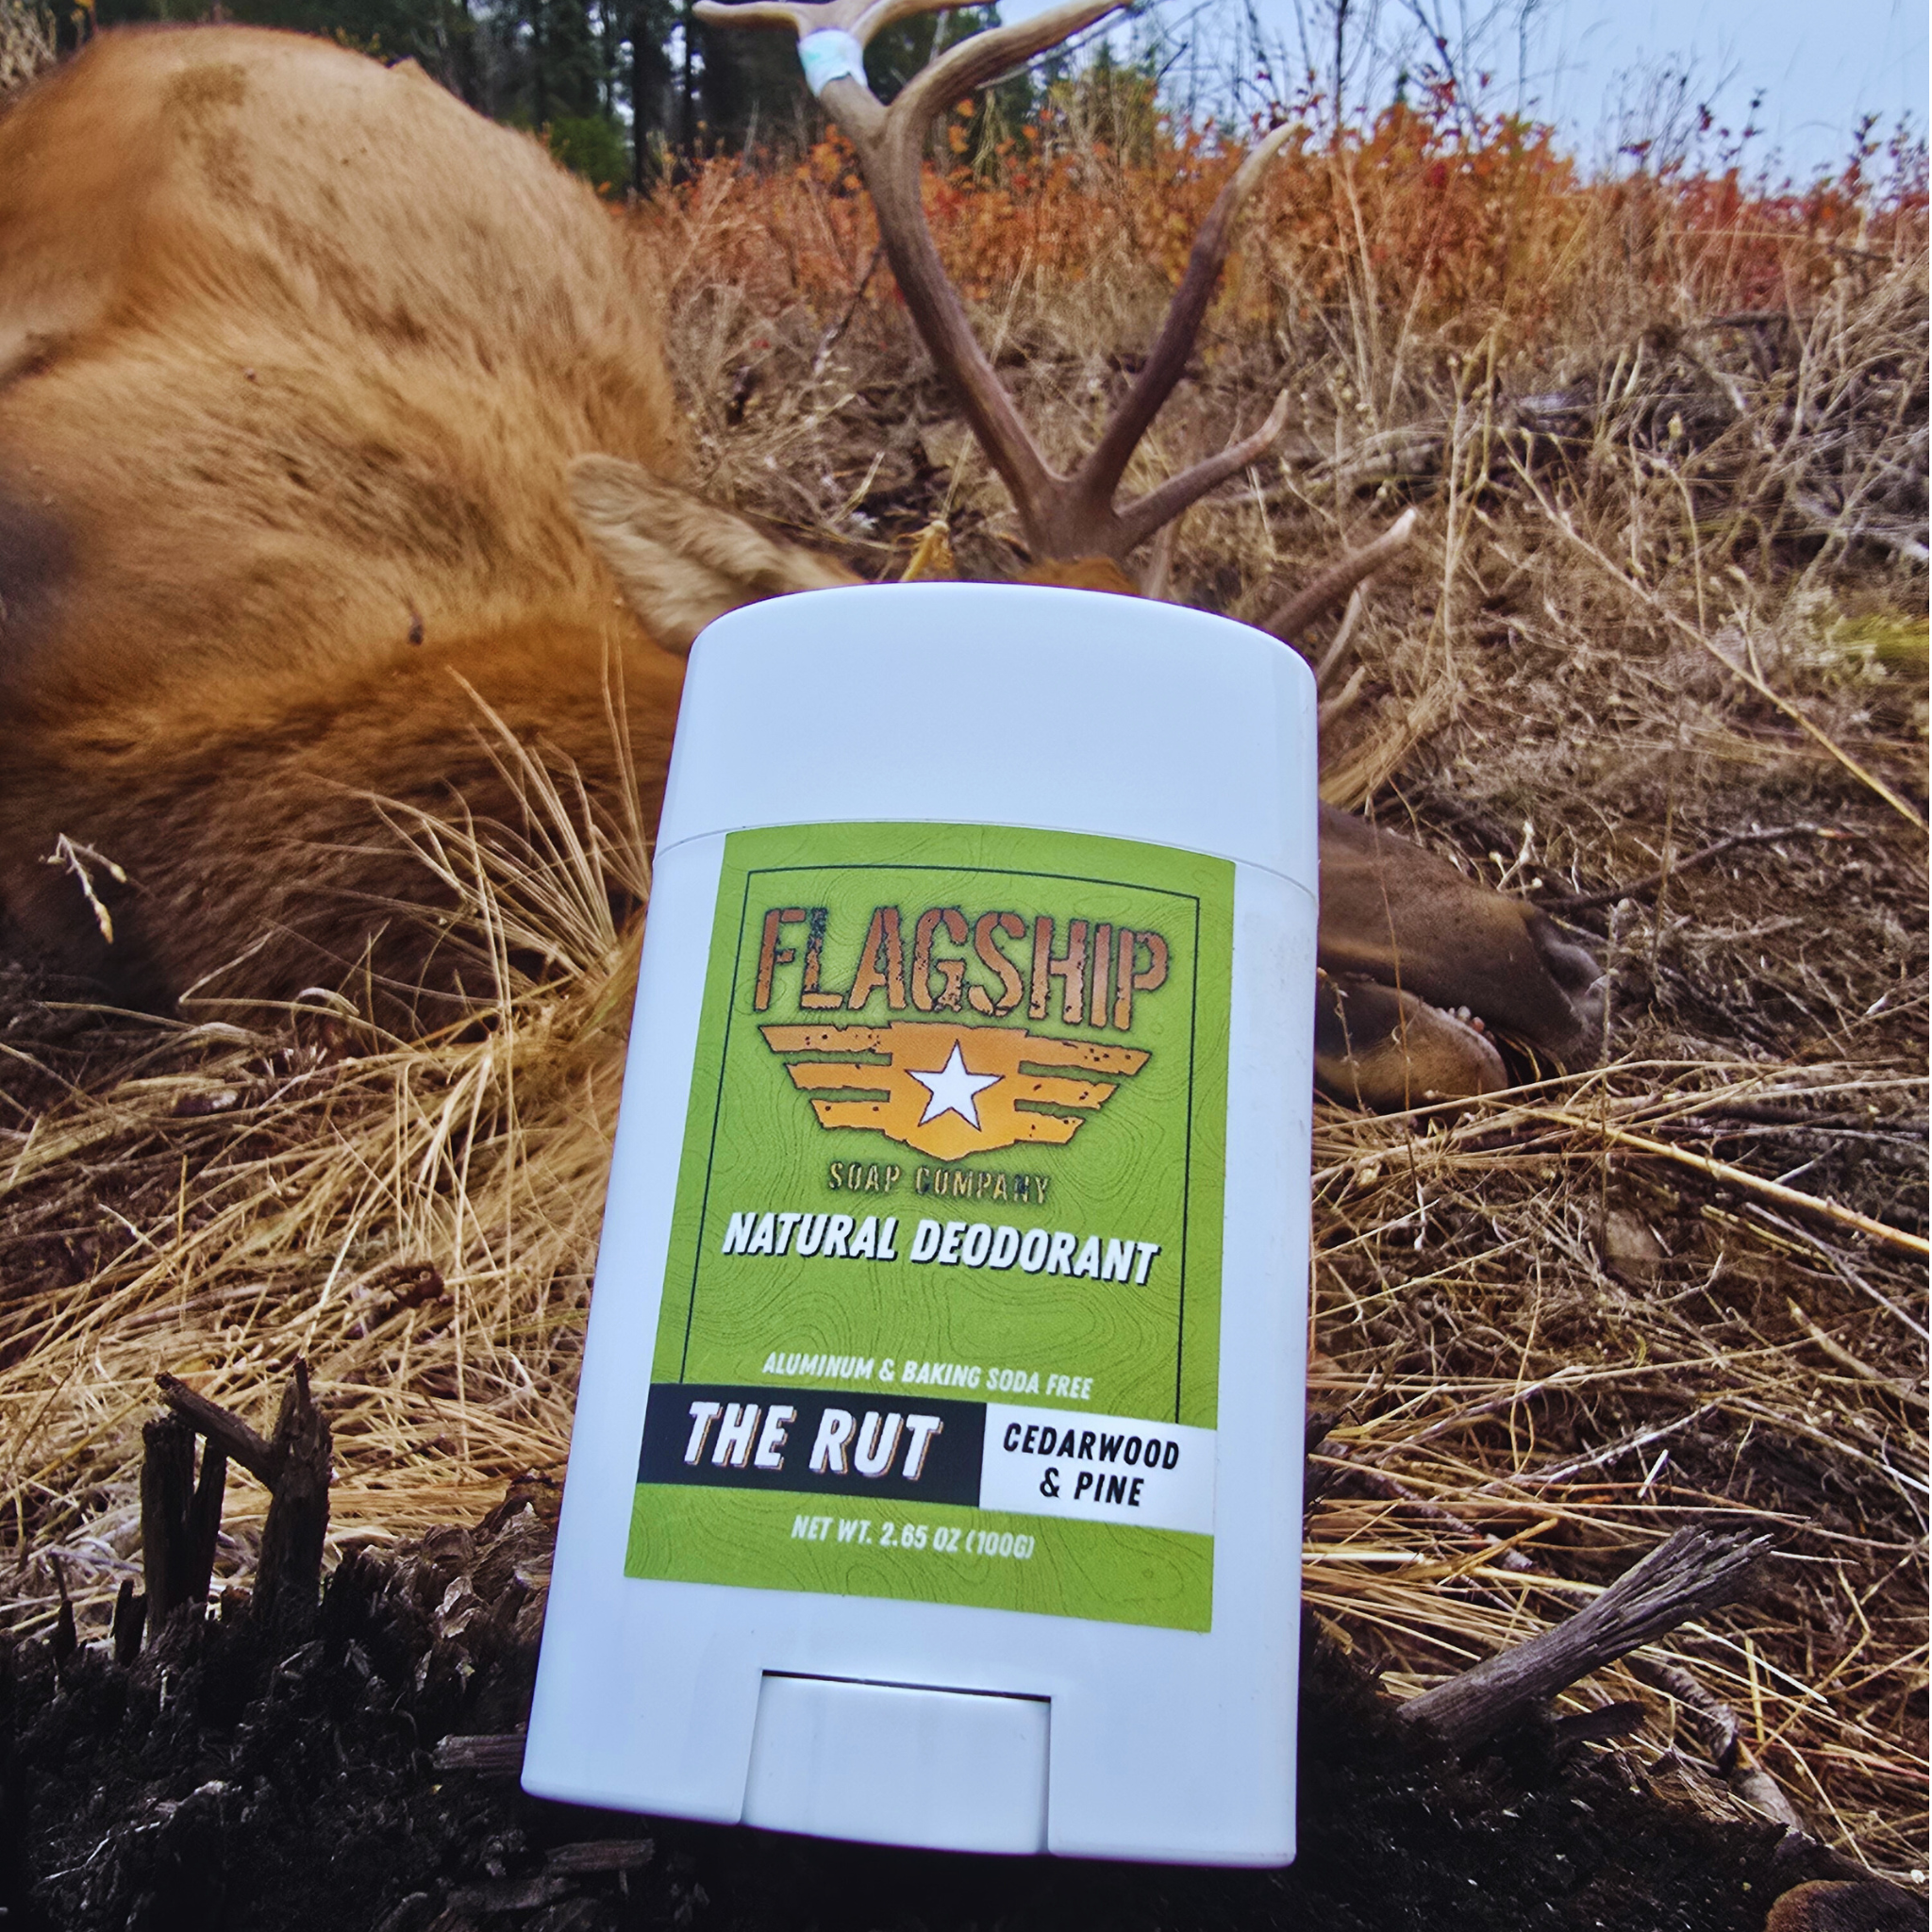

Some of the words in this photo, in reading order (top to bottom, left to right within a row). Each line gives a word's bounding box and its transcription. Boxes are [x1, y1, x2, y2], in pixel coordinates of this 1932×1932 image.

[754, 907, 1168, 1031] FLAGSHIP
[829, 1161, 902, 1193] SOAP
[916, 1166, 1050, 1205] COMPANY
[722, 1211, 898, 1262] NATURAL
[910, 1220, 1162, 1286] DEODORANT
[762, 1351, 874, 1382] ALUMINUM
[879, 1359, 894, 1382] &
[901, 1359, 981, 1391] BAKING
[986, 1366, 1040, 1395] SODA
[1046, 1374, 1095, 1401] FREE
[684, 1401, 796, 1471] THE
[808, 1407, 943, 1481] RUT
[1003, 1422, 1180, 1471] CEDARWOOD
[1039, 1468, 1060, 1498] &
[1074, 1471, 1144, 1507] PINE
[791, 1514, 833, 1541] NET
[835, 1519, 874, 1546] WT.
[879, 1522, 928, 1552] 2.65
[933, 1526, 962, 1554] OZ
[965, 1528, 1035, 1560] (100G)
